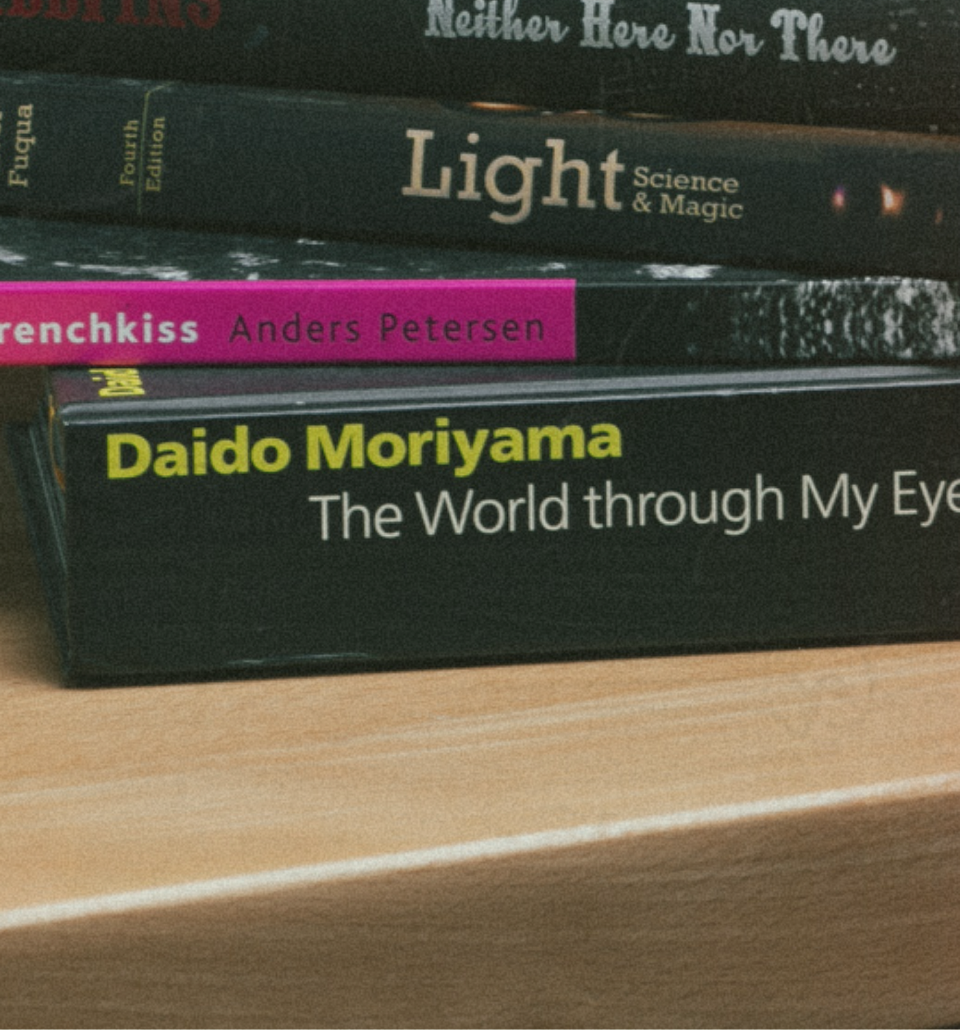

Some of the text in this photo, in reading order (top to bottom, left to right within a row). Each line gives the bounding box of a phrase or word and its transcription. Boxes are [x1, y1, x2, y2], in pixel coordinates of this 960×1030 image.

[686, 1, 765, 56] Nor
[770, 8, 897, 66] There
[8, 103, 36, 188] Fuqua
[119, 119, 139, 187] Fourth
[145, 116, 166, 193] Edition
[401, 128, 625, 225] Light
[631, 191, 744, 224] & Magic
[633, 165, 740, 194] Science
[0, 312, 199, 345] renchkiss
[229, 312, 544, 343] Anders Petersen
[106, 417, 623, 479] Daido Moriyama
[308, 491, 403, 541] The
[415, 482, 569, 536] World
[583, 473, 784, 536] through
[801, 473, 879, 530] My
